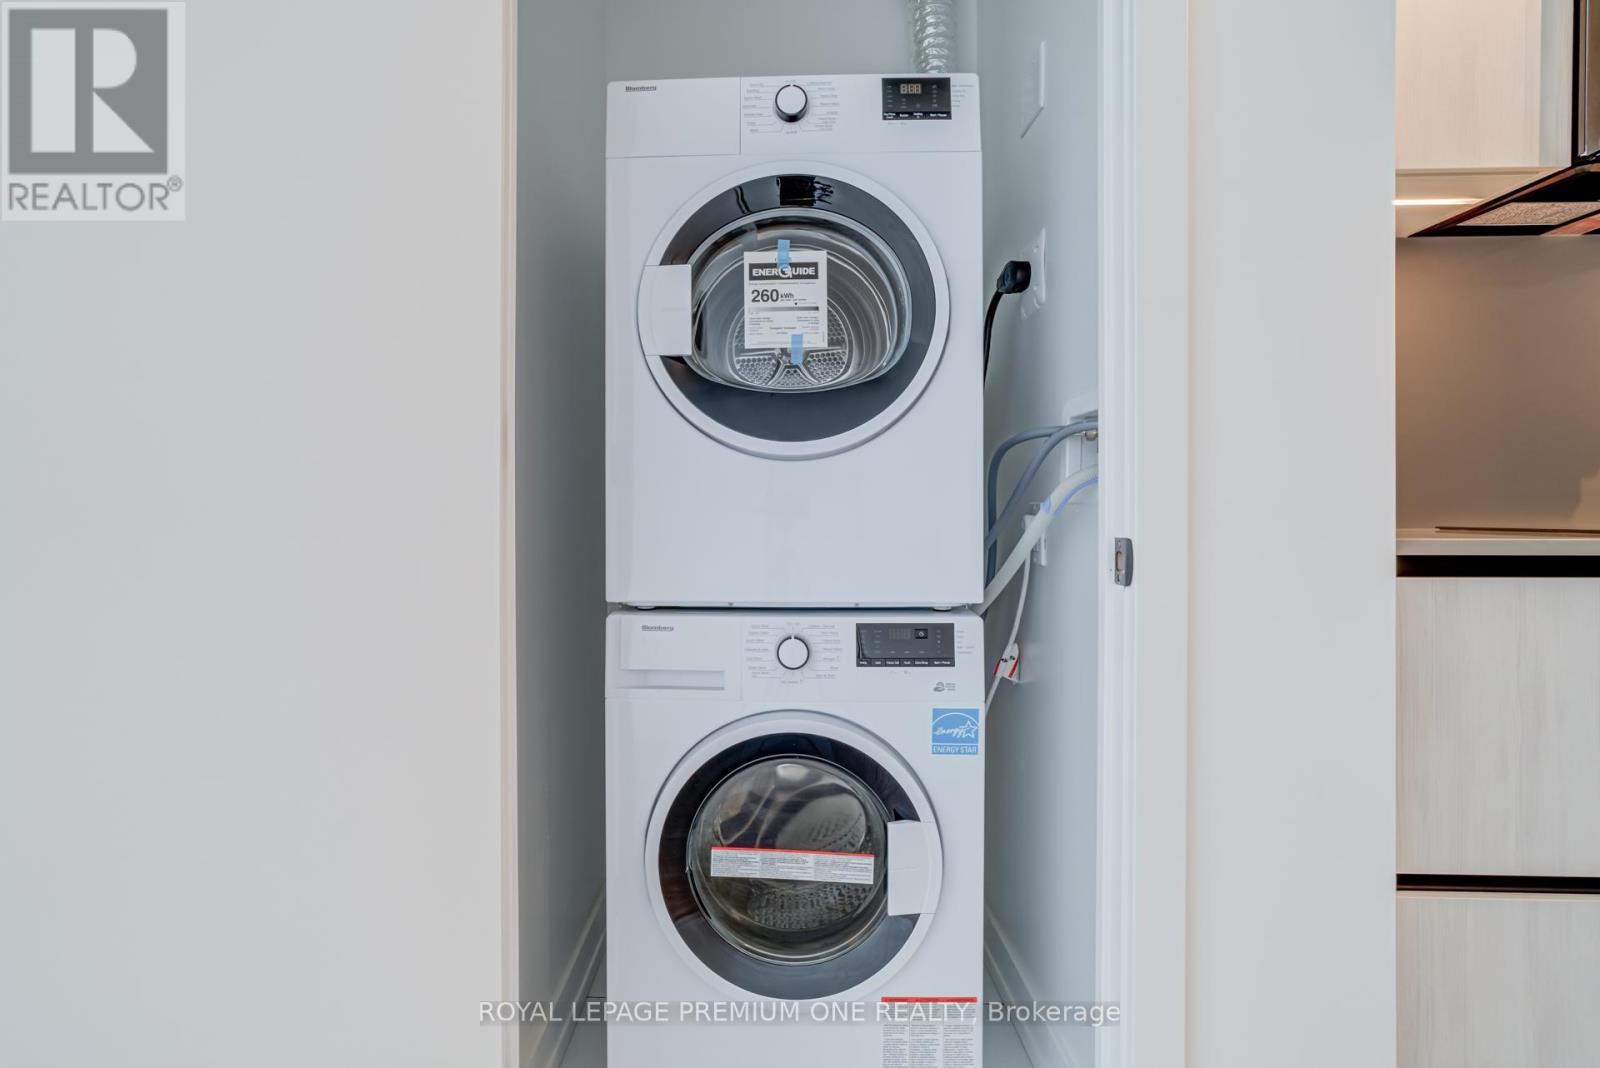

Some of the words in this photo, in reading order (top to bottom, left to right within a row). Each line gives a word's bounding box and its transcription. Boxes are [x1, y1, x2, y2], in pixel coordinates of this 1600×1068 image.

[752, 264, 816, 278] ENERGUIDE
[751, 289, 779, 303] 260
[960, 745, 977, 753] STAR
